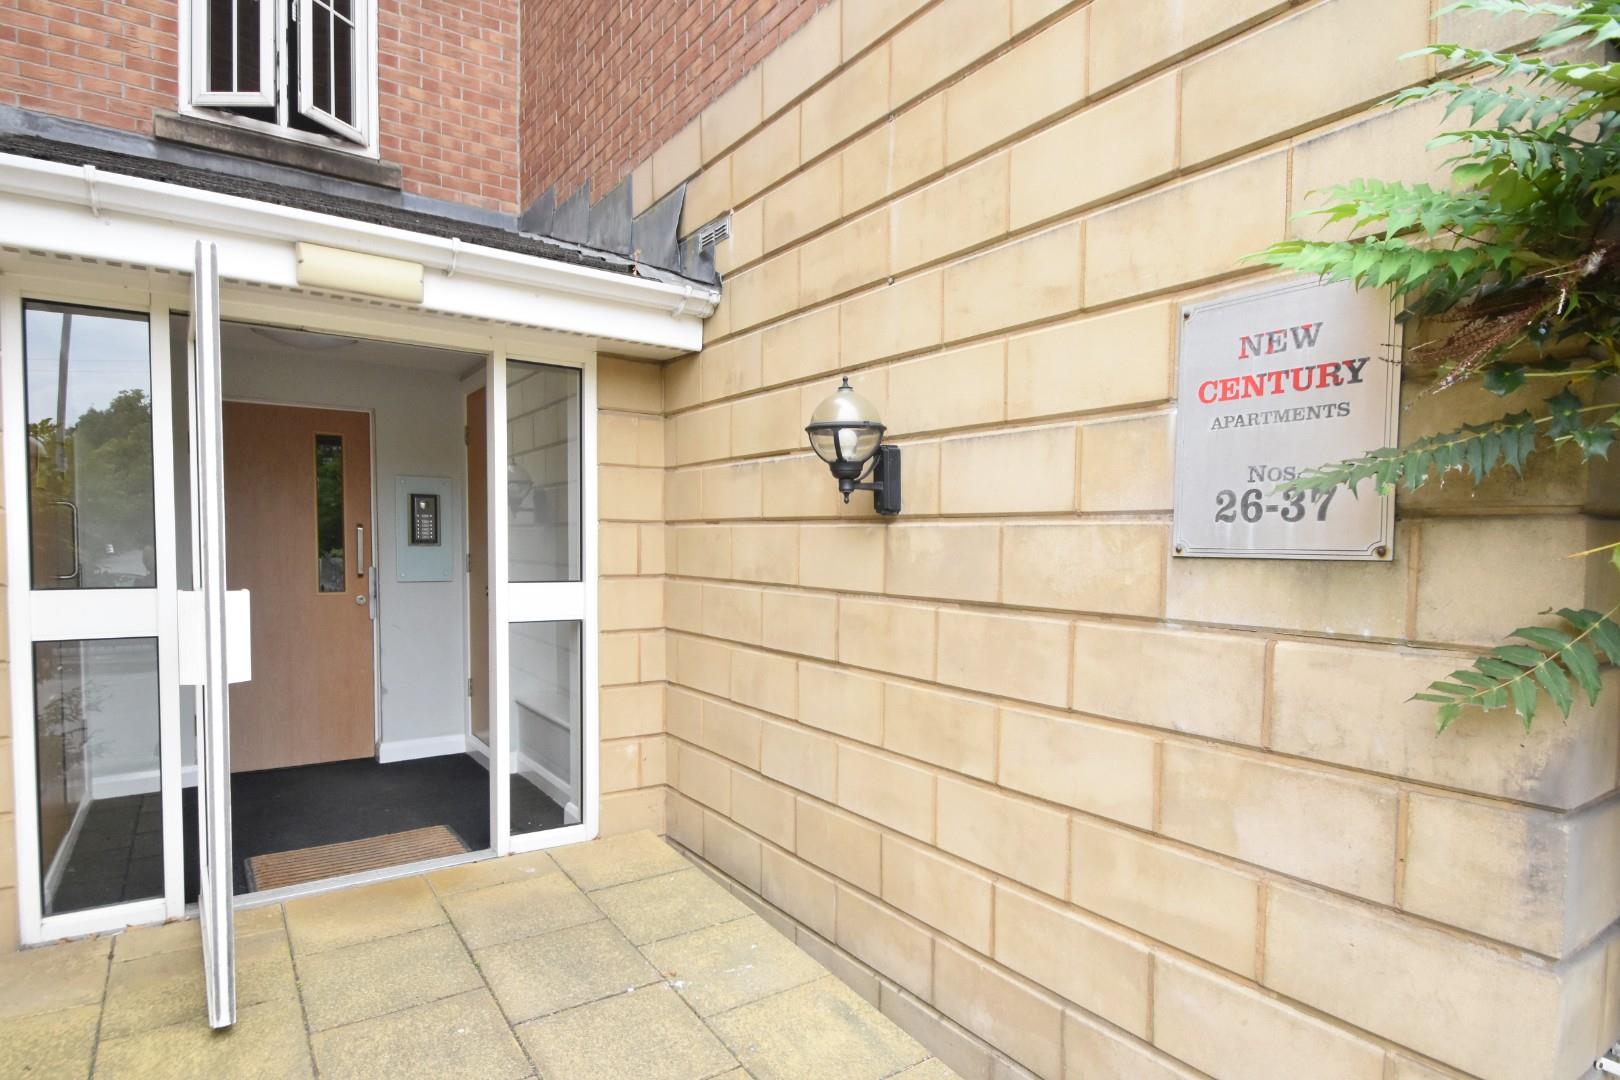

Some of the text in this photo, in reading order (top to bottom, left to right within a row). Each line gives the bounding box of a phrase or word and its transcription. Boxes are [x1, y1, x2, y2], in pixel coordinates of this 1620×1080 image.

[1238, 322, 1322, 360] NEW
[1198, 357, 1370, 404] CENTURY
[1211, 402, 1351, 430] APARTMENTS
[1215, 488, 1337, 523] 26-37
